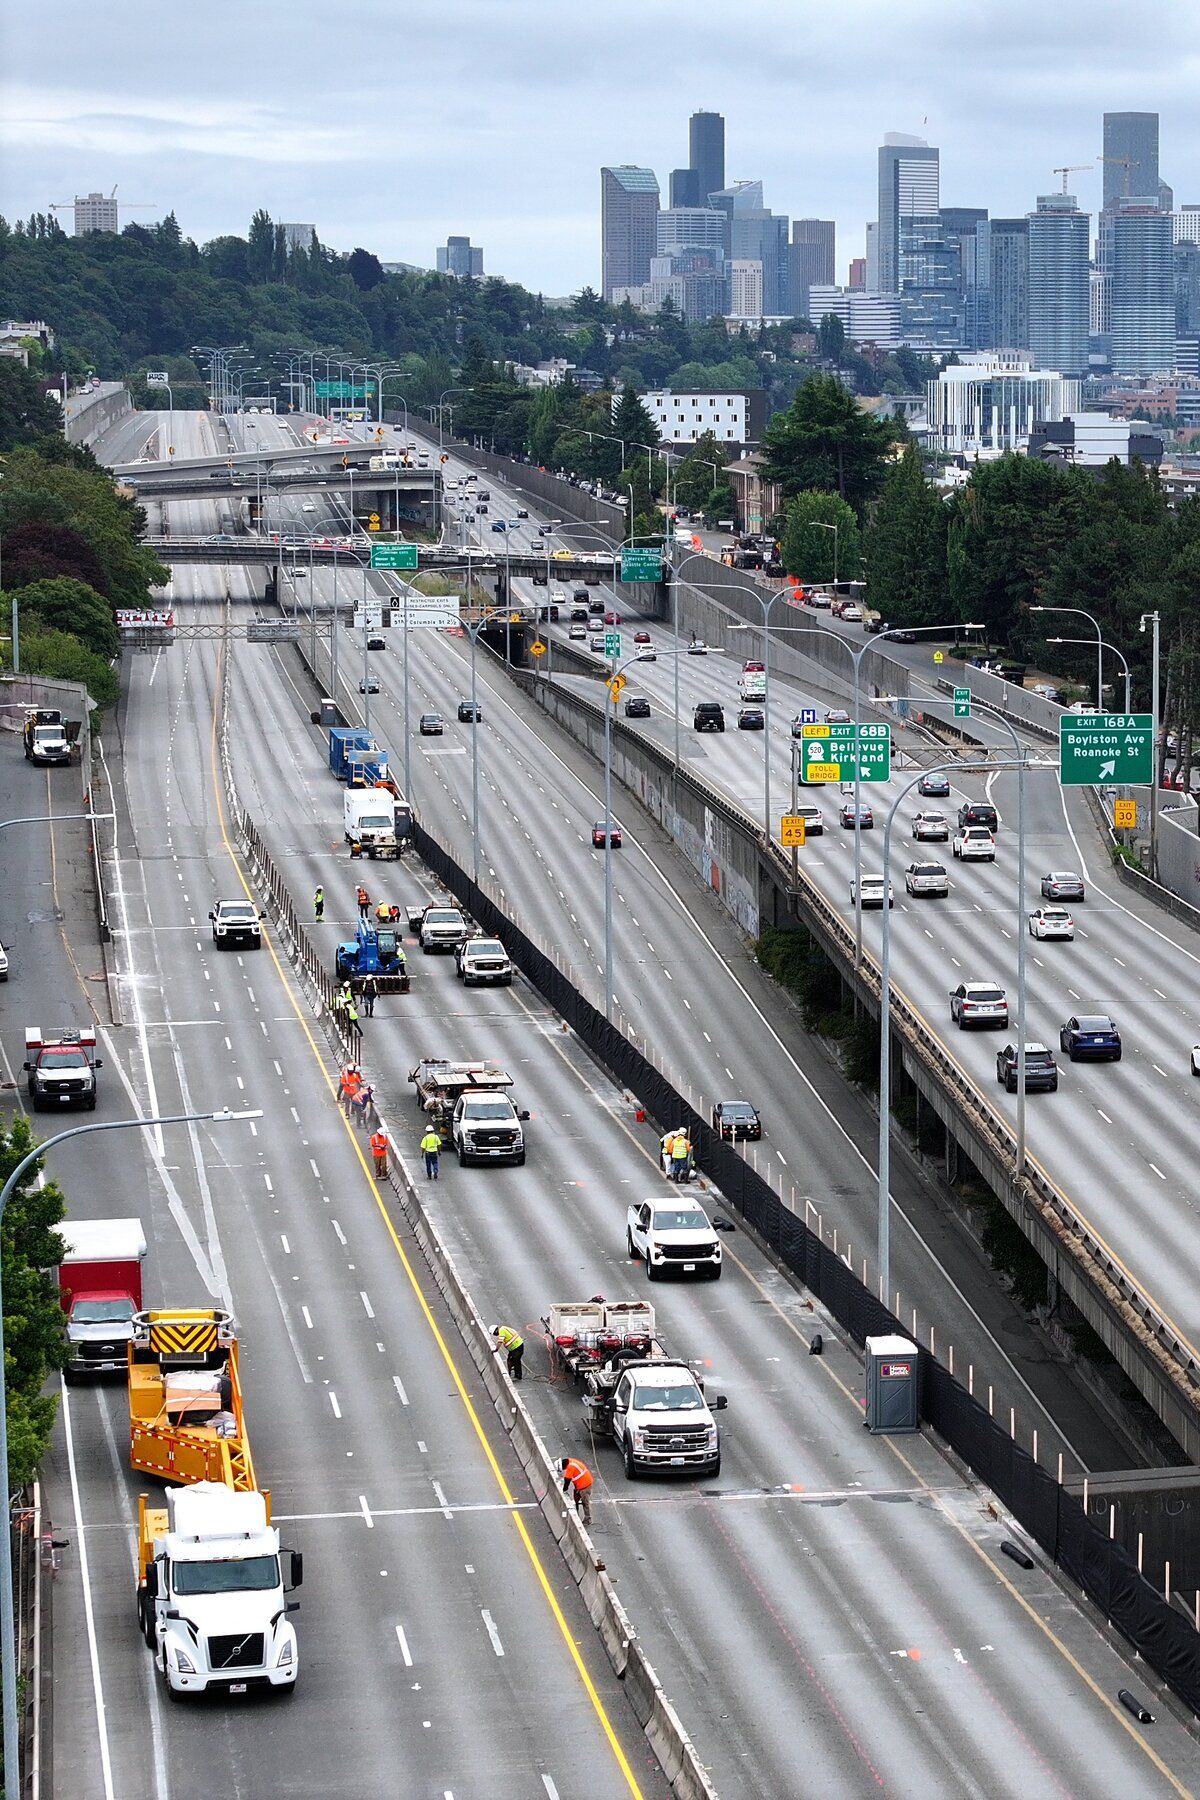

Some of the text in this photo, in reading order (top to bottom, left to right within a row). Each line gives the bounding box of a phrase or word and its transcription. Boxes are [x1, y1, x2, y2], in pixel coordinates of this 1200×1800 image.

[803, 710, 813, 722] H
[1076, 718, 1097, 726] EXIT
[805, 726, 887, 737] LEFT EXIT 68B
[1067, 734, 1145, 746] Boylston Ave
[810, 746, 822, 754] 520
[1073, 747, 1139, 757] Roanoke St
[1118, 812, 1133, 821] 30
[785, 828, 802, 838] 45
